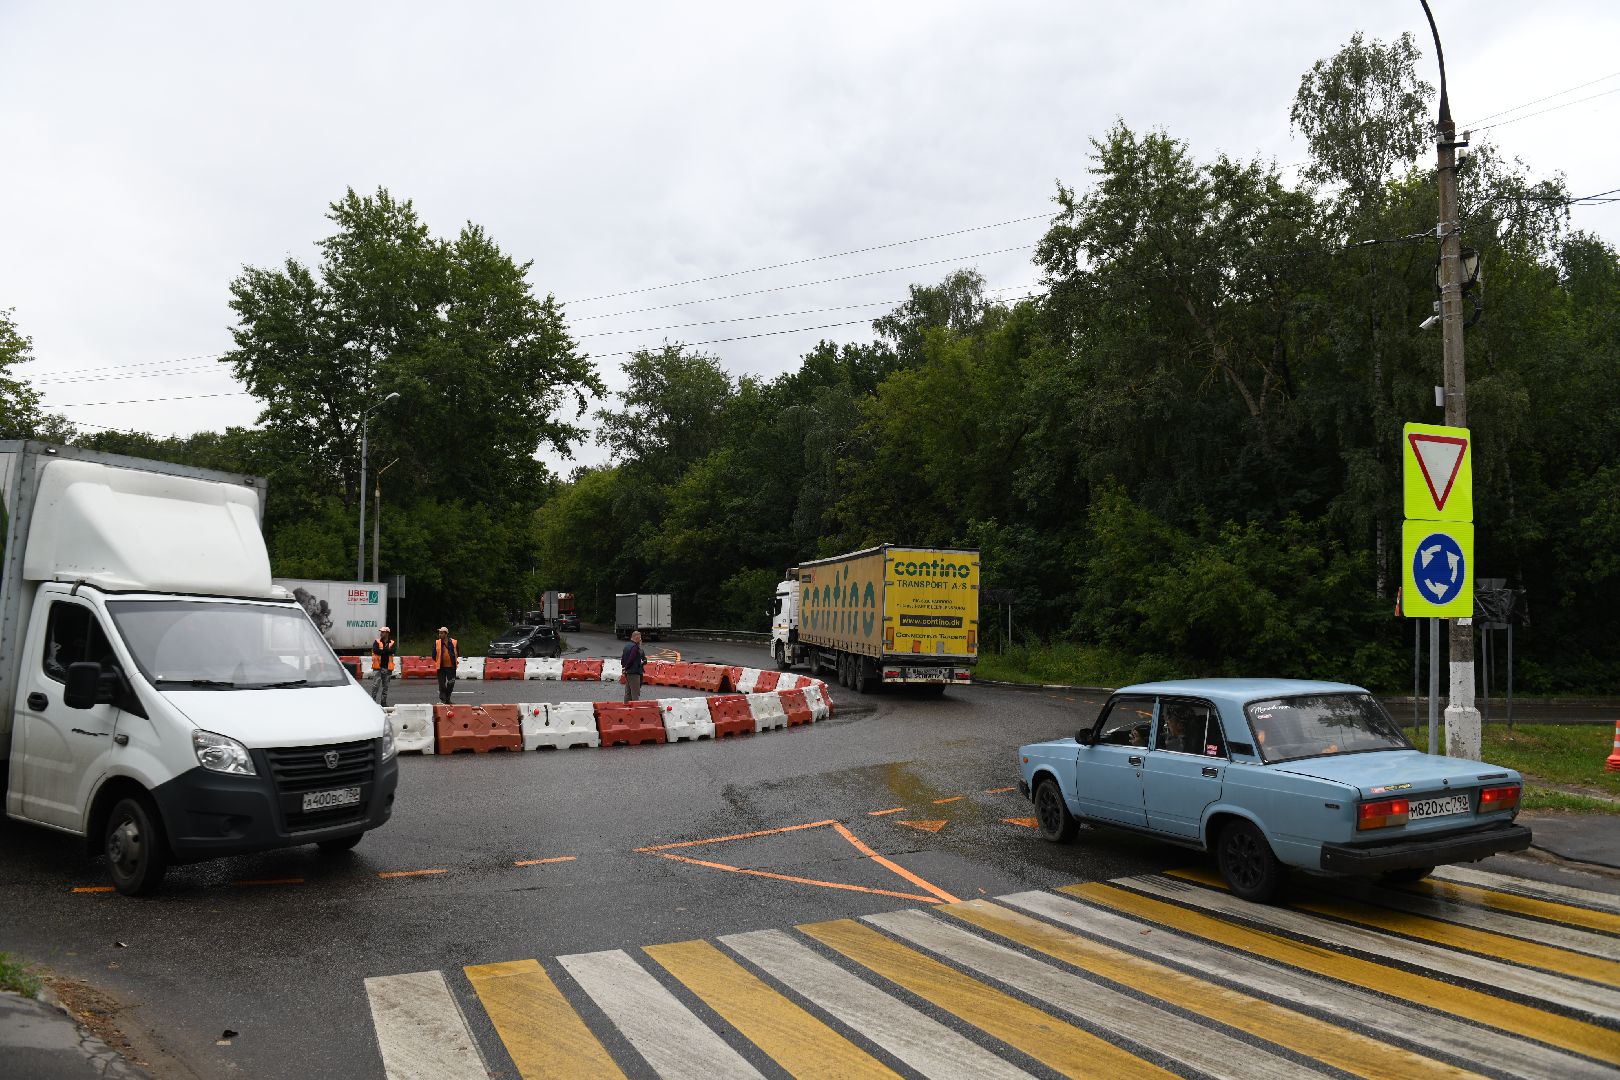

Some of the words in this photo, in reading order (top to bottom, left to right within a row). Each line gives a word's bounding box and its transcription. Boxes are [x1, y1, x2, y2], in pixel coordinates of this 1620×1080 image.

[894, 558, 970, 579] contino
[896, 579, 949, 590] TRANSPORT
[802, 564, 876, 638] contino
[902, 617, 961, 627] www.contino.dk
